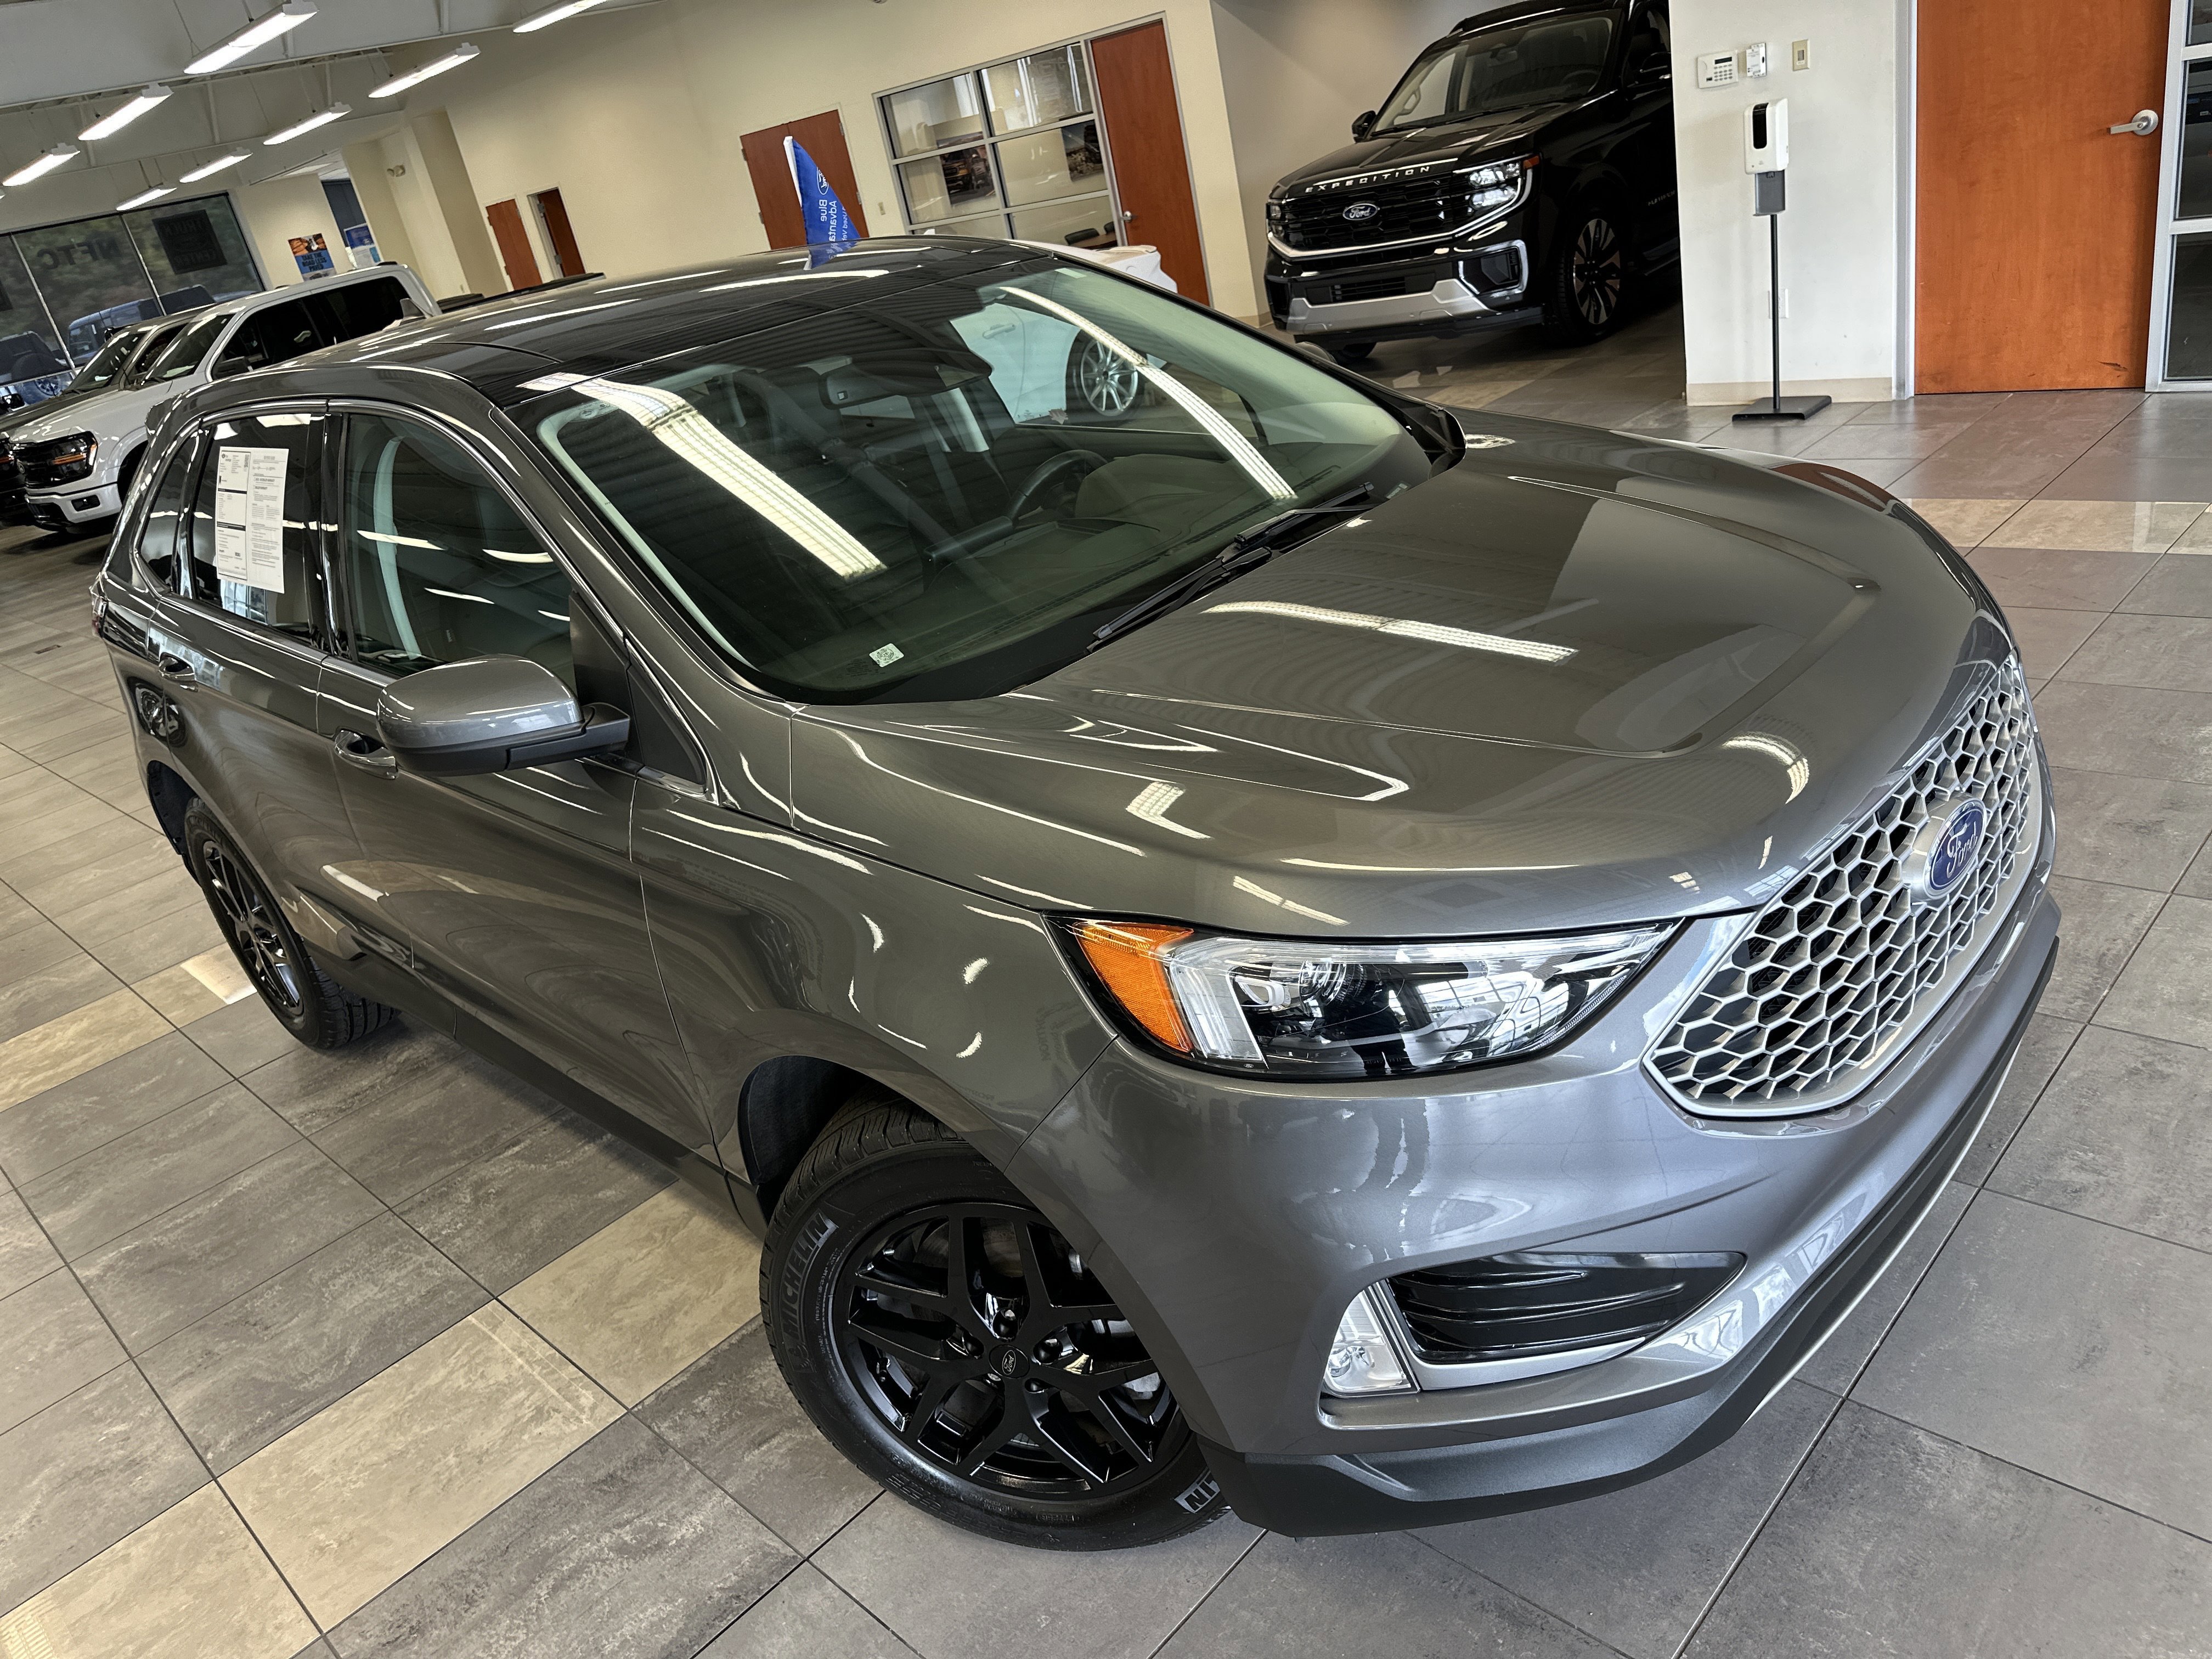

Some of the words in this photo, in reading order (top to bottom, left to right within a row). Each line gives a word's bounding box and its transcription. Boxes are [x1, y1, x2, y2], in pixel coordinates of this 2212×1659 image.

[1305, 166, 1430, 193] EXPEDITION
[1946, 821, 1978, 878] Ford
[781, 1209, 834, 1342] MICHELIN
